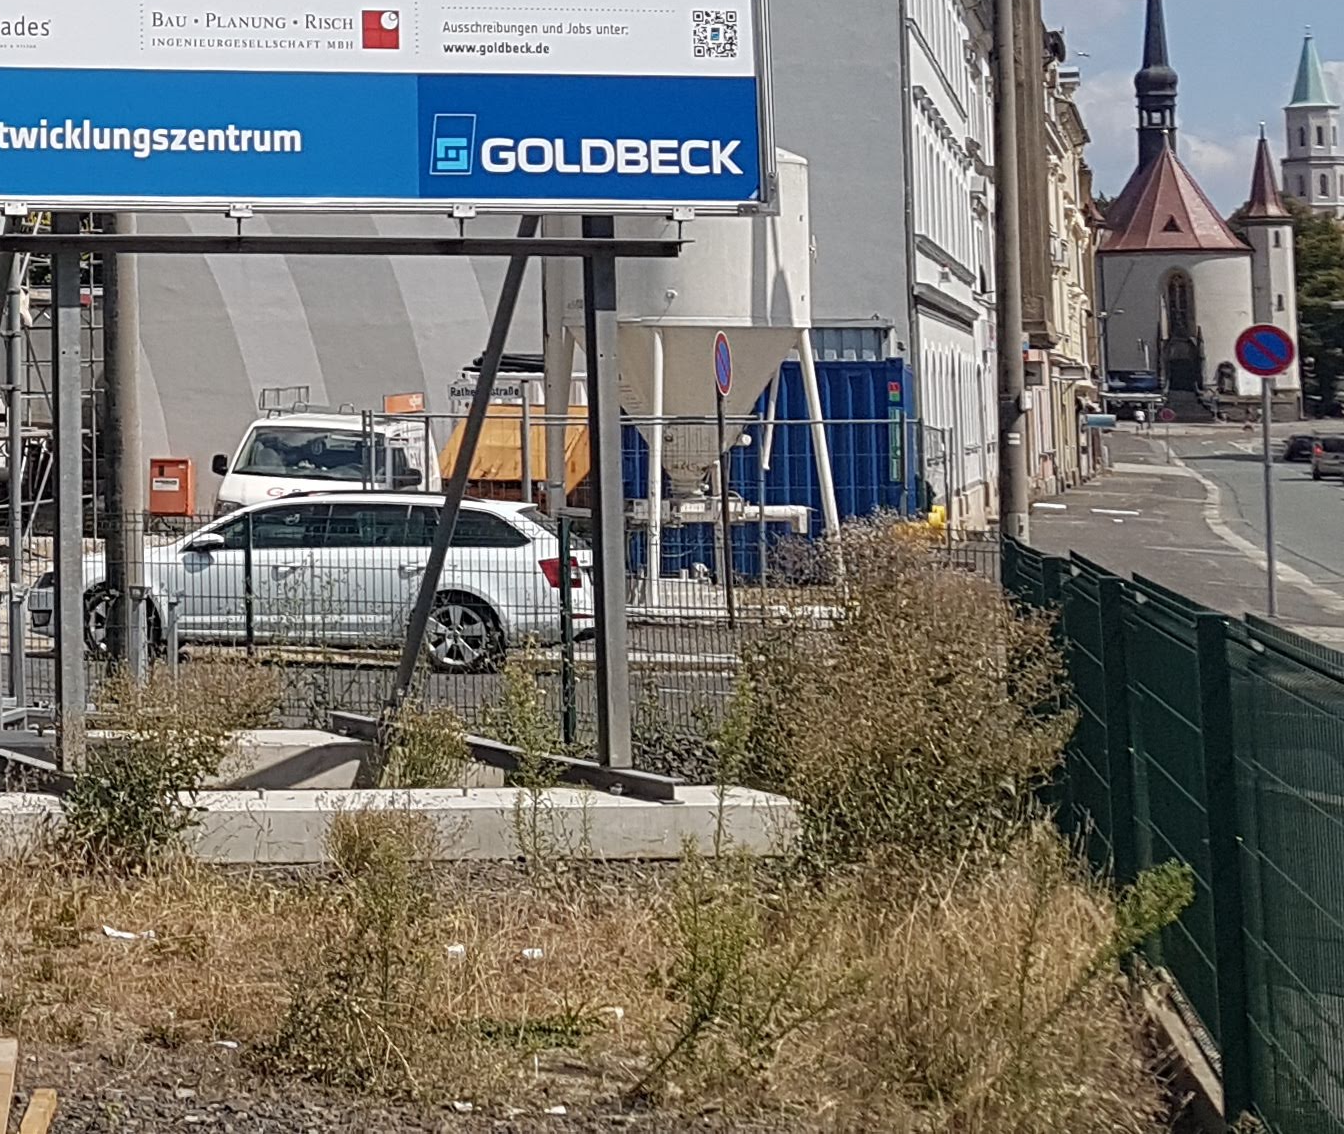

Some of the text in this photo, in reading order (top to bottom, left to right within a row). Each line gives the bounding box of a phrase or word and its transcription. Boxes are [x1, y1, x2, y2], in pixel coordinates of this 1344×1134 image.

[152, 12, 353, 30] BAU PLANUNG RISCH
[442, 21, 629, 37] Ausschreibungen und Jobs unter:
[152, 38, 353, 50] INGENIEURGESELLSCHAFT MBH
[443, 42, 550, 56] www.goldbeck.de
[480, 137, 744, 175] GOLDBECK
[450, 386, 520, 398] Rathestraße
